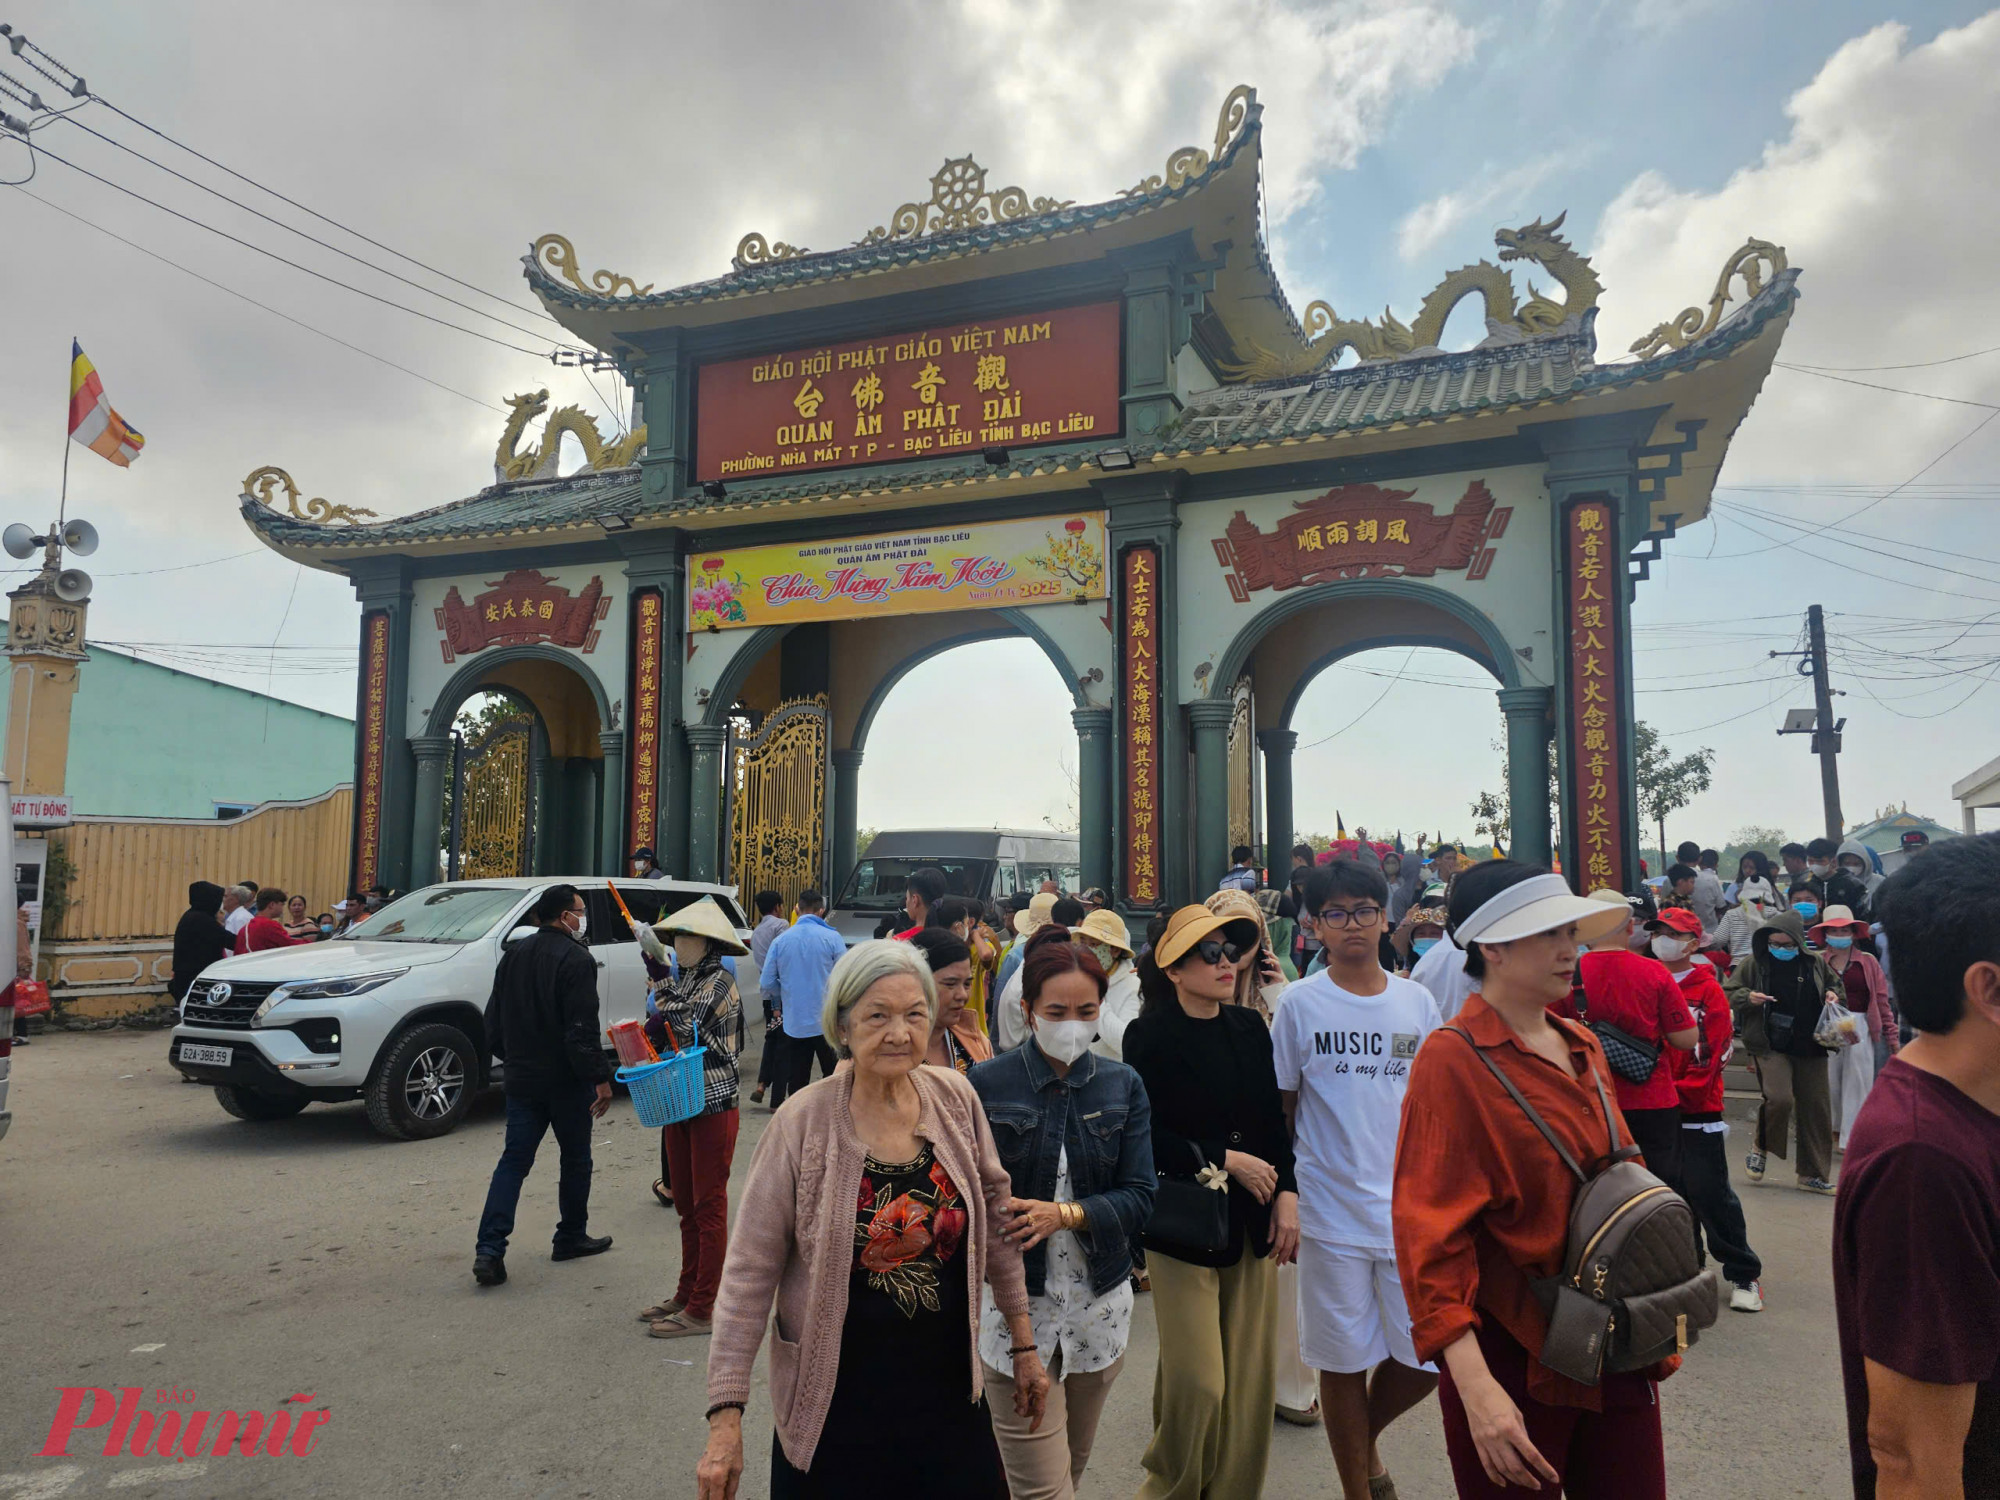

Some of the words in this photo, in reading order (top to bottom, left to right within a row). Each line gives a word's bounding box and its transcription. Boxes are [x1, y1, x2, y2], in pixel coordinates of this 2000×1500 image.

[752, 353, 794, 383] GIÁO
[800, 350, 832, 379] HỘI
[838, 345, 889, 371] PHẬT
[895, 332, 942, 362] GIÁO
[950, 326, 996, 355] VIỆT
[1003, 321, 1051, 346] NAM
[776, 420, 833, 446] QUAN
[854, 410, 883, 437] ÂM
[903, 401, 961, 433] PHẬT
[983, 390, 1022, 422] ĐÀI
[721, 451, 775, 474] PHƯỜNG
[780, 447, 807, 466] NHÀ
[813, 442, 843, 462] MÁT
[904, 436, 933, 455] BẠC
[939, 428, 972, 448] LIÊU
[1021, 421, 1051, 440] BẠC
[1058, 412, 1095, 433] LIÊU
[892, 538, 911, 548] NAM
[761, 572, 821, 605] Chúc
[814, 567, 890, 602] Mừng
[890, 560, 944, 591] Năm
[938, 555, 1015, 591] Mới
[1019, 579, 1062, 598] 2025
[1314, 1031, 1383, 1056] MUSIC
[1335, 1060, 1349, 1074] is
[1355, 1064, 1378, 1080] my
[1384, 1060, 1407, 1082] life
